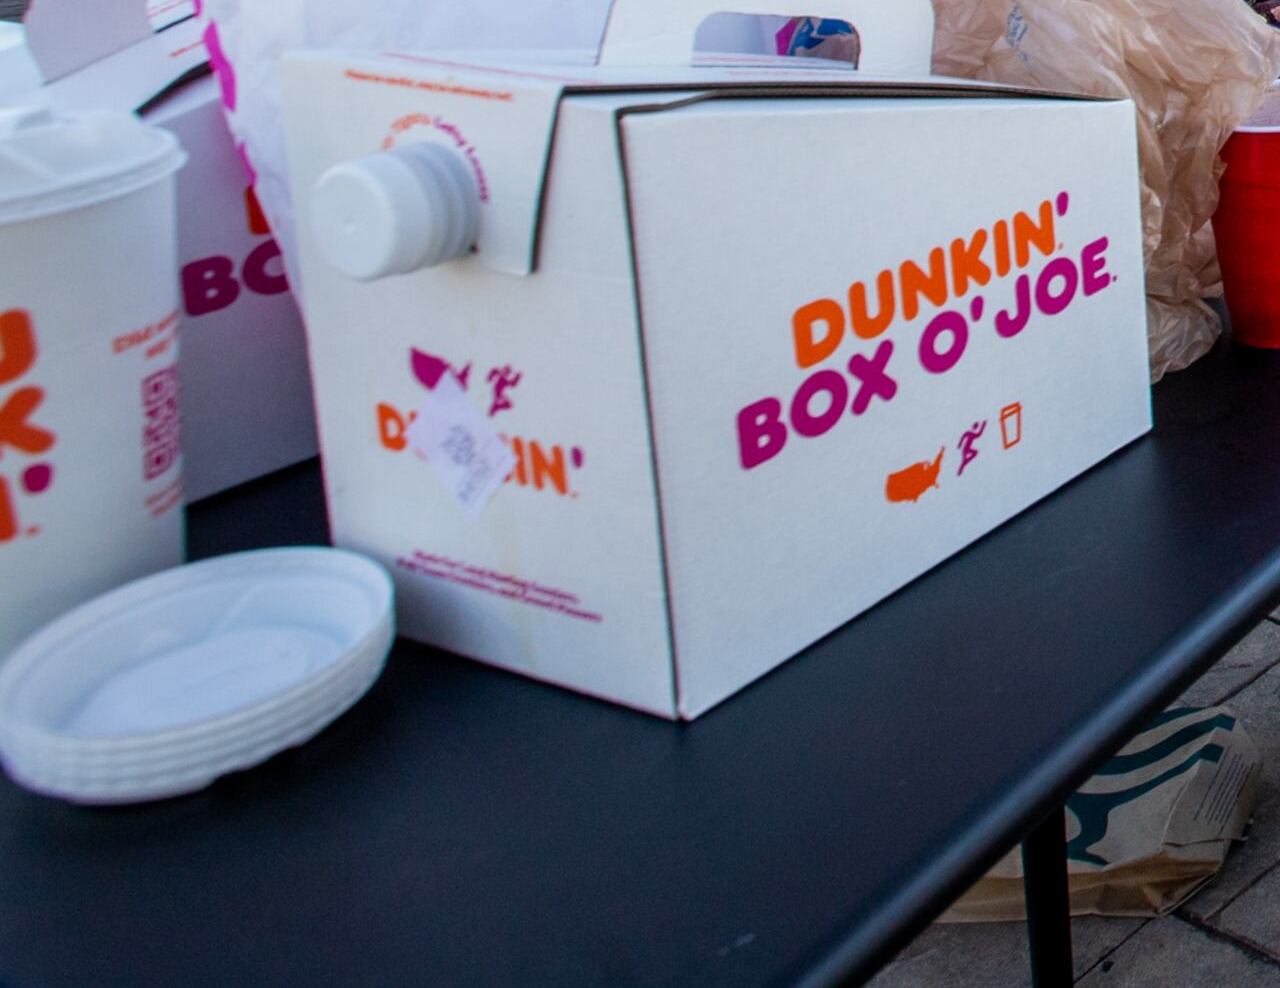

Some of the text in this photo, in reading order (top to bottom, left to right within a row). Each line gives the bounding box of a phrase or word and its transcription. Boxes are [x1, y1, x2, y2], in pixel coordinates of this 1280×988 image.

[180, 254, 292, 317] BO
[791, 190, 1070, 370] DUNKIN'
[375, 401, 586, 497] DIN'
[735, 338, 899, 471] BOX
